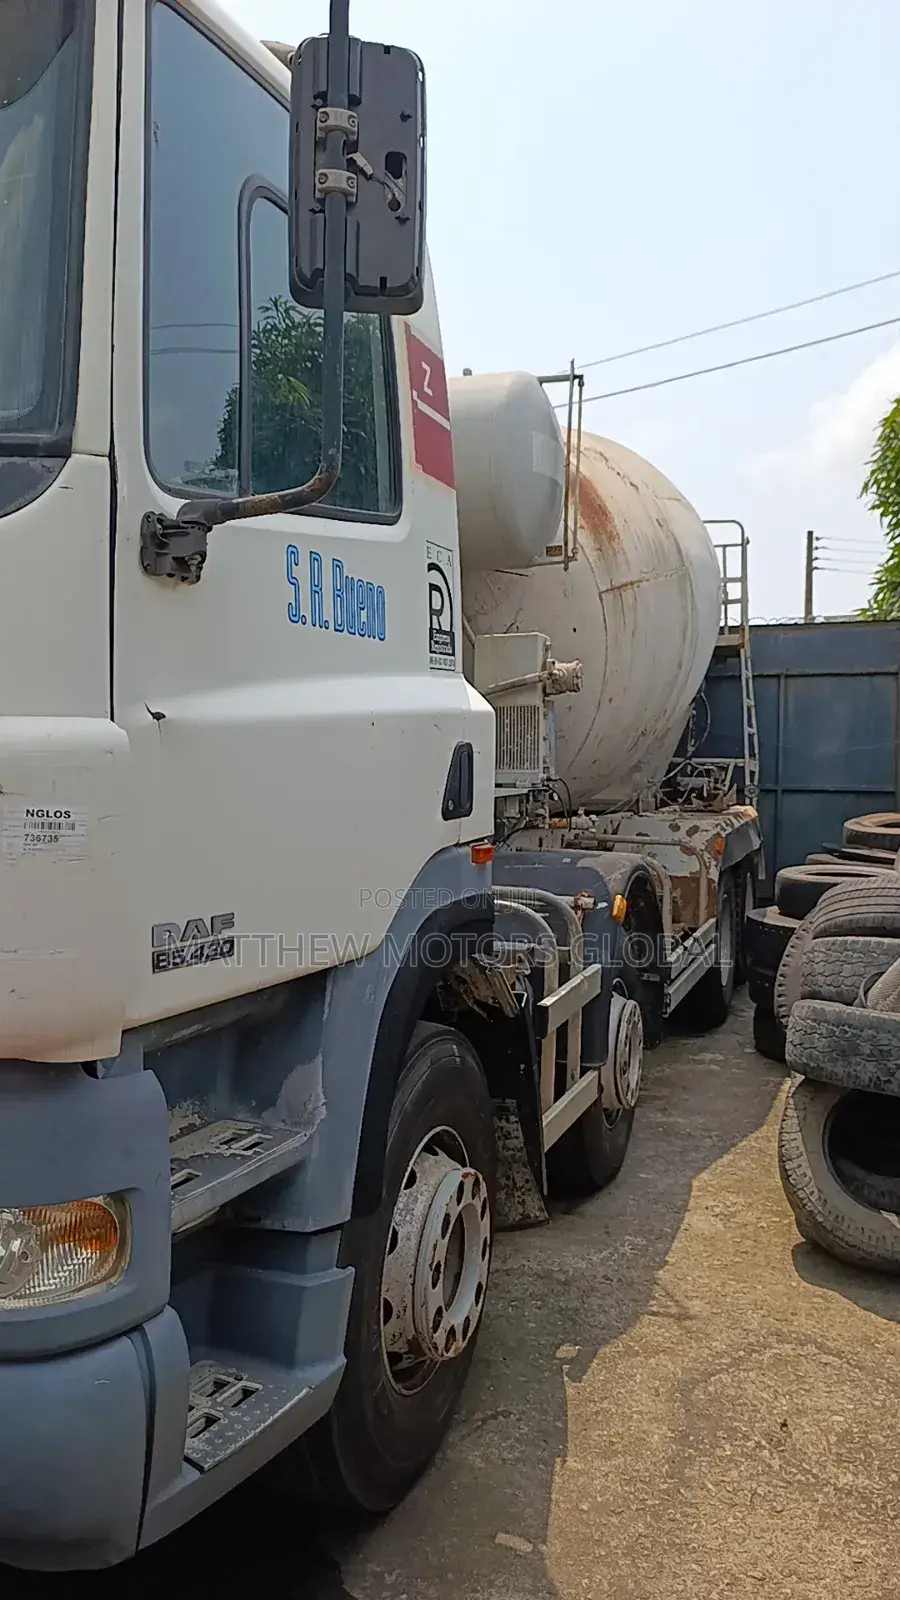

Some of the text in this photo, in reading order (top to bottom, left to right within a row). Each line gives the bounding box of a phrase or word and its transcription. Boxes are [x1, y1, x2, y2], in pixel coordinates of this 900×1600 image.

[25, 809, 72, 818] NGLOS
[24, 834, 60, 843] 736735
[152, 912, 235, 948] DAF
